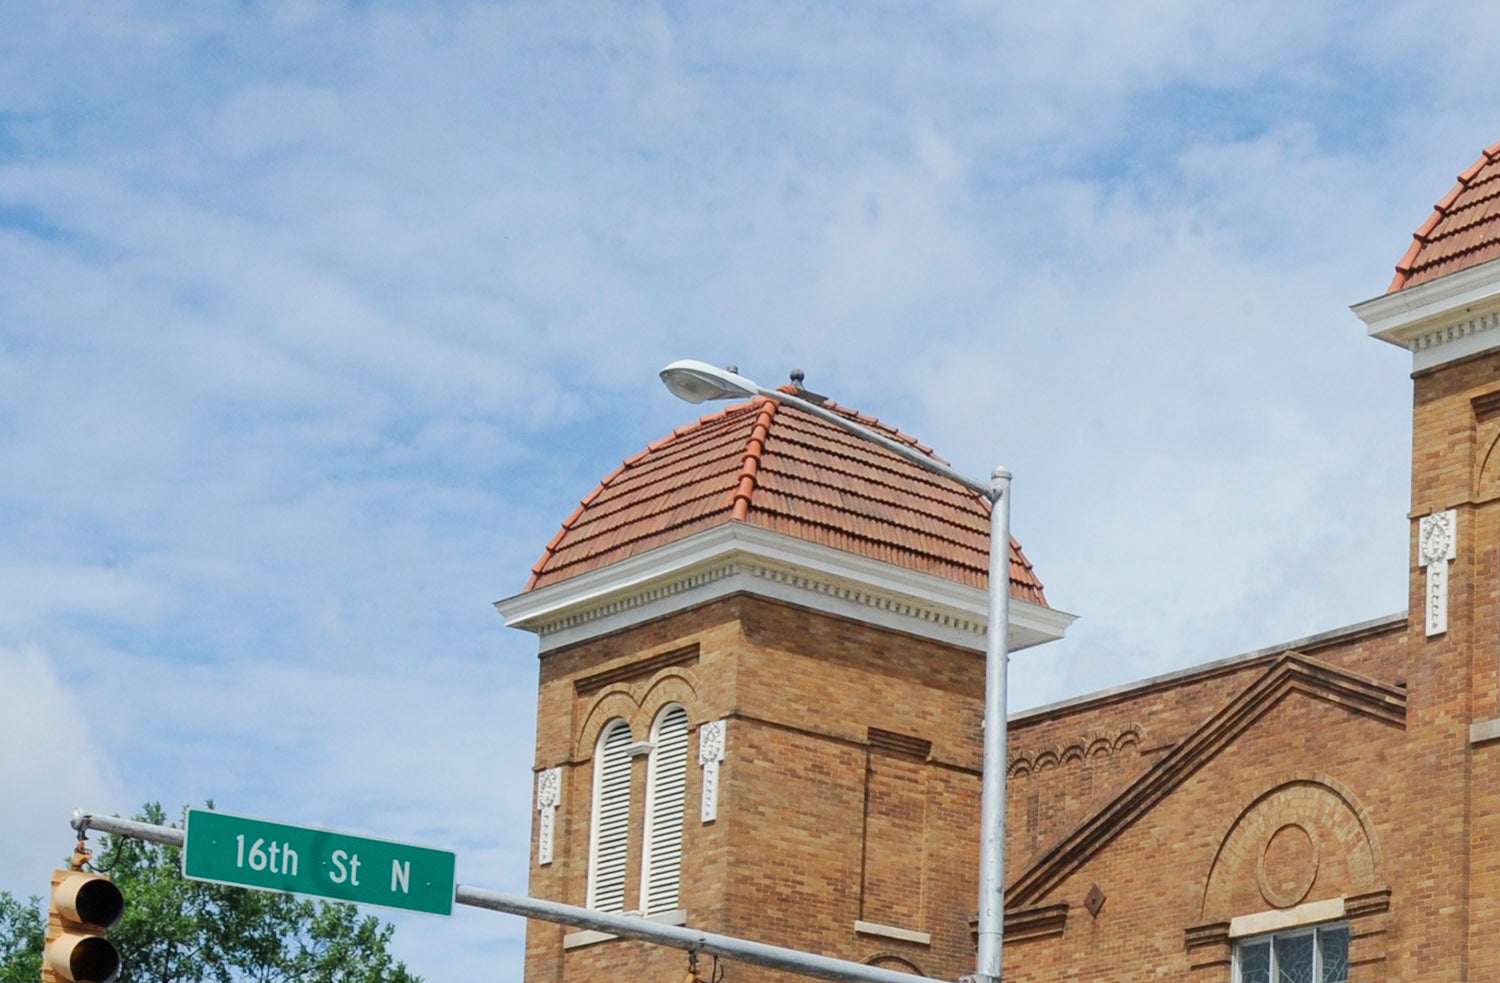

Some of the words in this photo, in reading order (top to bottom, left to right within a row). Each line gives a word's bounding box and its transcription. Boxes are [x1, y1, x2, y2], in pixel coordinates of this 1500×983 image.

[236, 833, 299, 877] 16th
[328, 849, 362, 887] St
[390, 859, 411, 894] N
